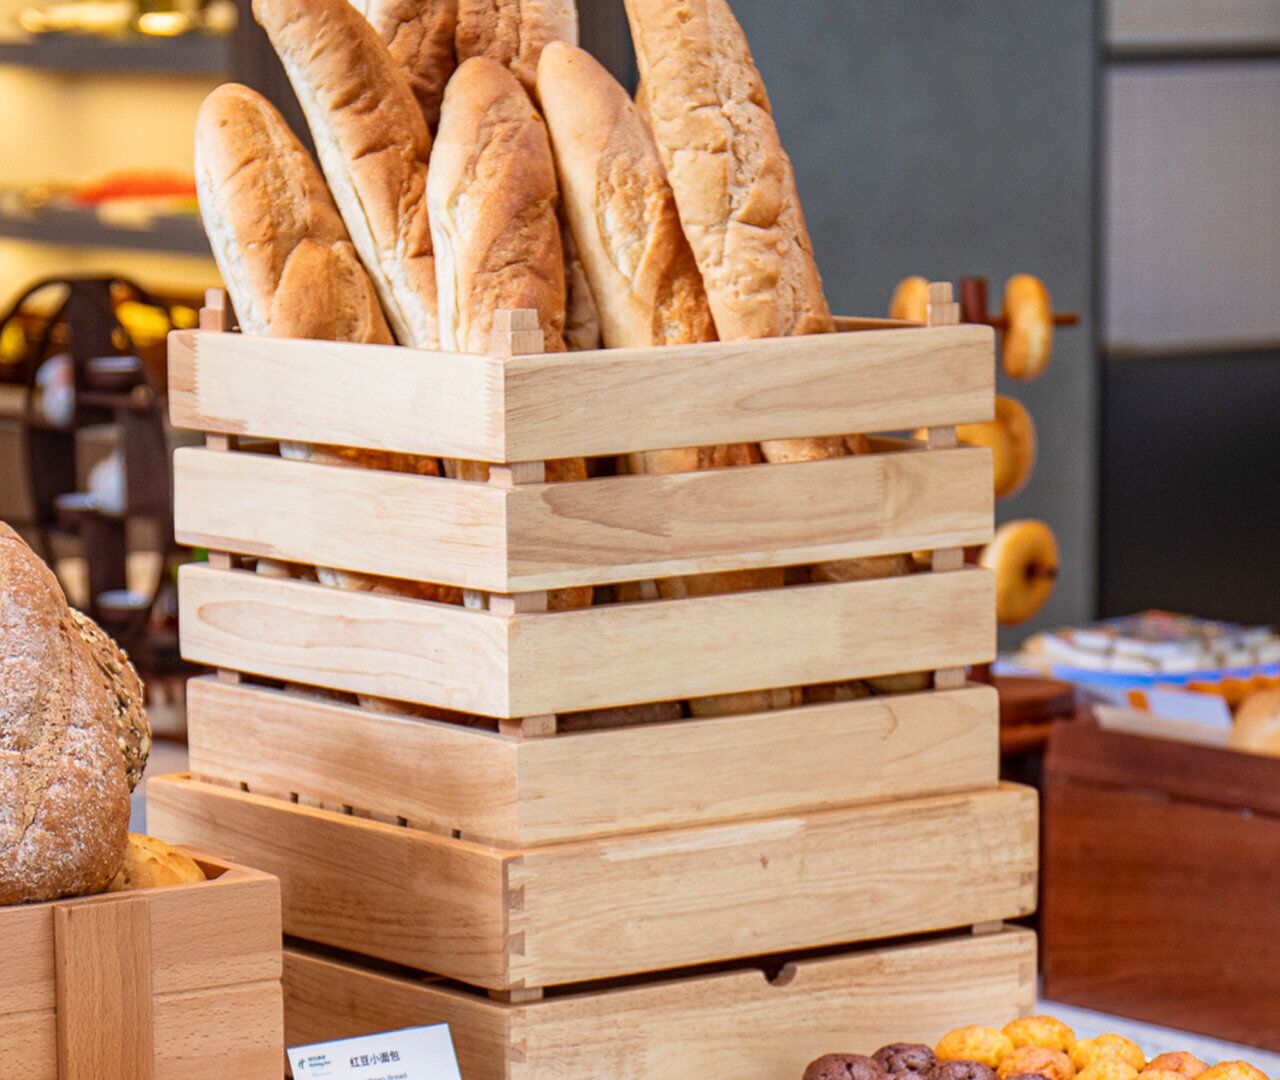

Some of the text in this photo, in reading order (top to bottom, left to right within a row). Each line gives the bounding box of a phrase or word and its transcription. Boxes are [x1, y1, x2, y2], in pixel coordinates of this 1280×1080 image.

[349, 1050, 400, 1067] 红豆小面包
